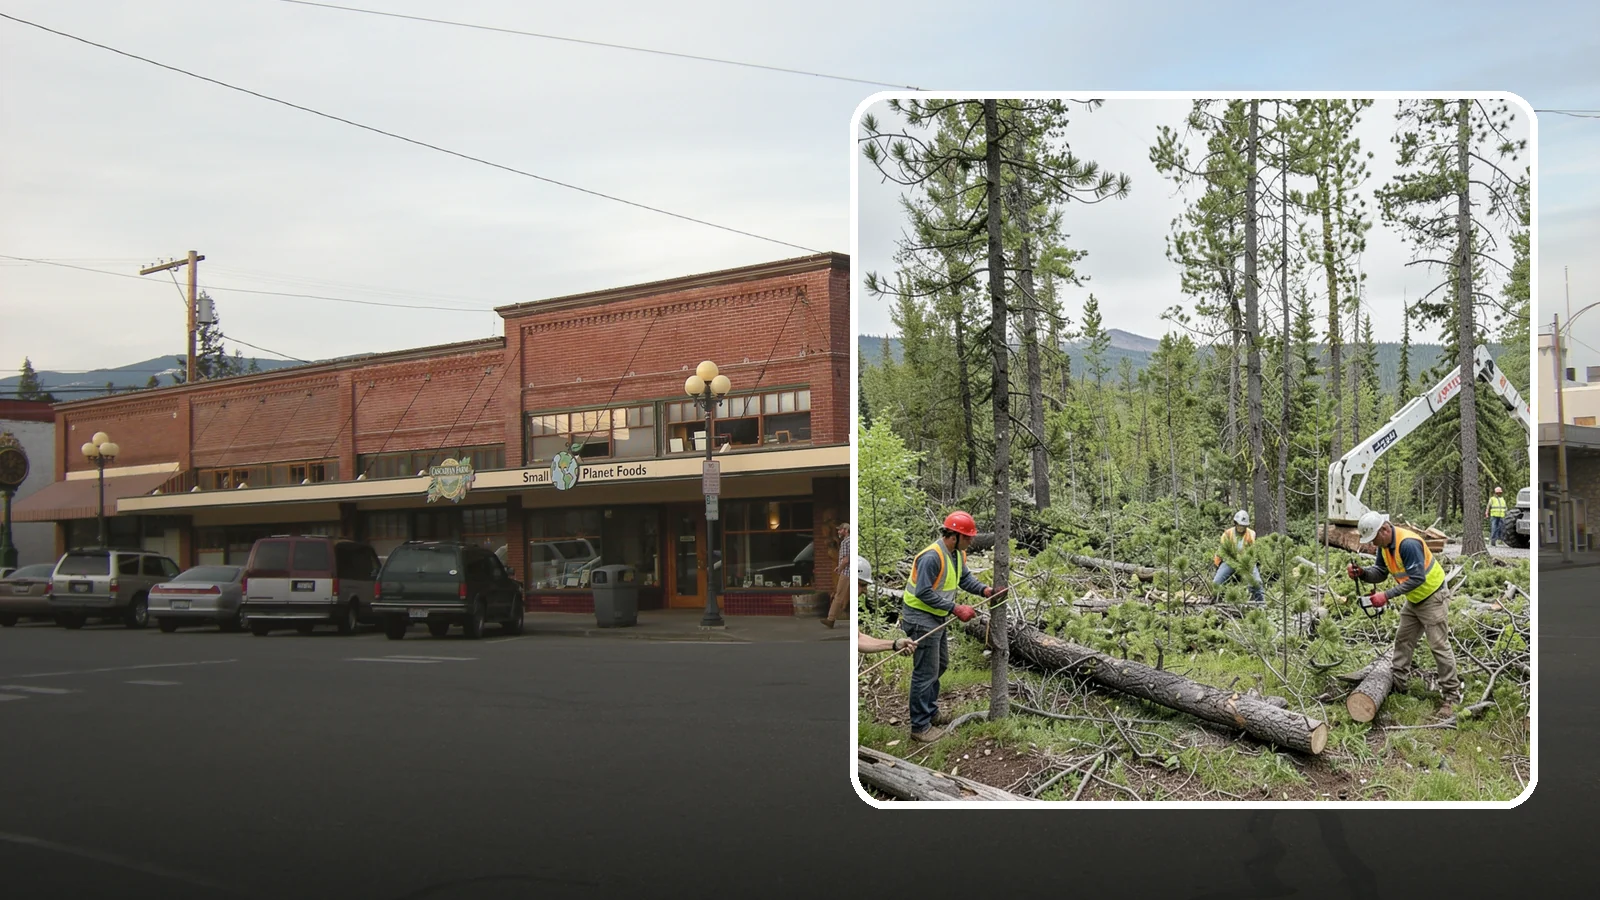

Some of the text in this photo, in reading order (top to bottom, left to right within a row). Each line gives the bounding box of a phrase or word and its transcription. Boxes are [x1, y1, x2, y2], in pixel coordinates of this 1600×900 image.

[523, 464, 647, 482] Small Planet Foods
